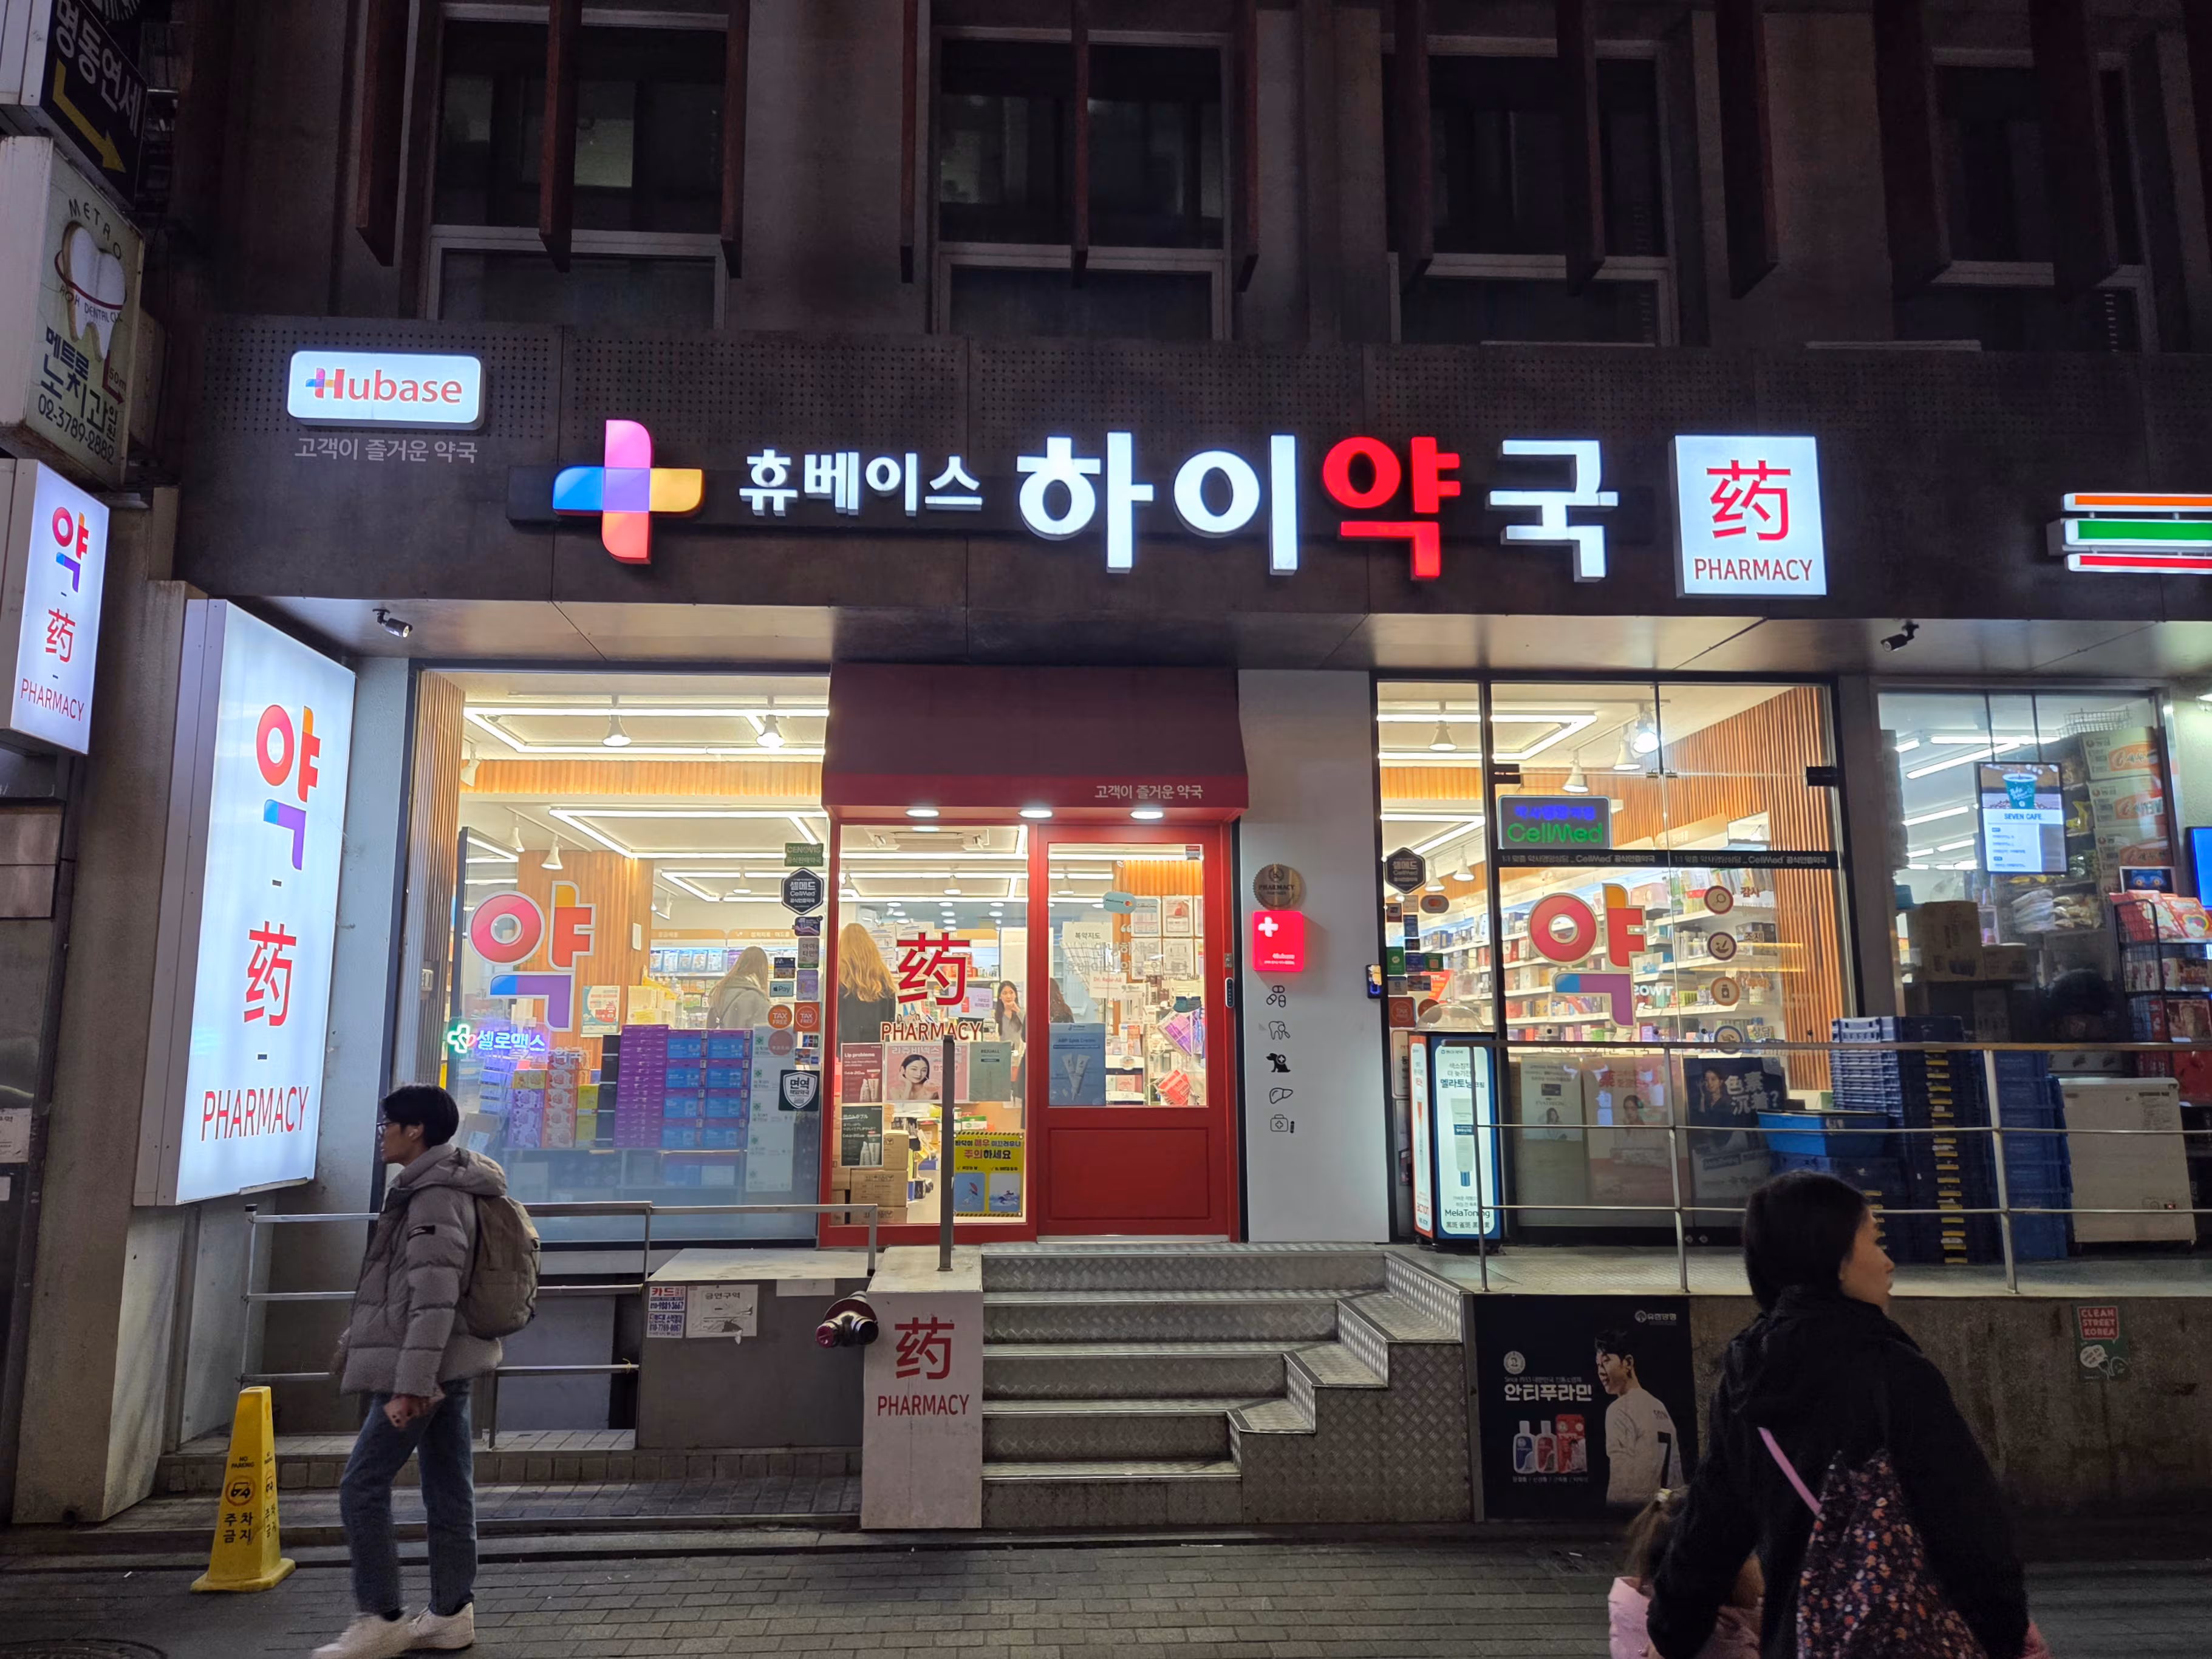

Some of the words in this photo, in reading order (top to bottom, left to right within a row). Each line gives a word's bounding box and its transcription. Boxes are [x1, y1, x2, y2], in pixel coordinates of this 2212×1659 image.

[69, 199, 121, 260] METRO
[46, 325, 89, 381] 메트로
[108, 367, 127, 392] 50m
[306, 367, 463, 404] Hubase
[38, 393, 114, 466] 02-3789-2882
[295, 438, 358, 460] 고객이
[365, 440, 429, 462] 즐거운
[434, 441, 478, 463] 약국
[739, 449, 983, 516] 휴베이스
[1017, 432, 1619, 582] 하이약국
[1706, 459, 1792, 542] 药
[52, 506, 89, 593] 약
[1694, 558, 1813, 581] PHARMACY
[46, 608, 76, 663] 药
[21, 678, 84, 722] PHARMACY
[256, 704, 321, 871] 약
[1094, 785, 1133, 799] 고객이
[1136, 785, 1174, 799] 즐거운
[1177, 785, 1203, 799] 약국
[1507, 822, 1603, 843] CellMed
[790, 882, 816, 890] 셀메드
[468, 882, 595, 1030] 약
[1528, 884, 1647, 1027] 약
[244, 920, 297, 1027] 药
[897, 932, 970, 1006] 药
[478, 1030, 545, 1052] 셀로맥스
[881, 1023, 983, 1040] PHARMACY
[790, 1077, 810, 1089] 면역
[200, 1085, 310, 1142] PHARMACY
[964, 1150, 1011, 1159] 주의하세요
[1445, 1209, 1490, 1218] MelaTonng
[652, 1287, 674, 1296] 카드
[2081, 1309, 2114, 1318] CLEAN
[2082, 1318, 2115, 1327] STREET
[895, 1317, 955, 1380] 药
[878, 1394, 969, 1416] PHARMACY
[1504, 1384, 1592, 1401] 안티푸라민
[223, 1529, 252, 1544] 금지
